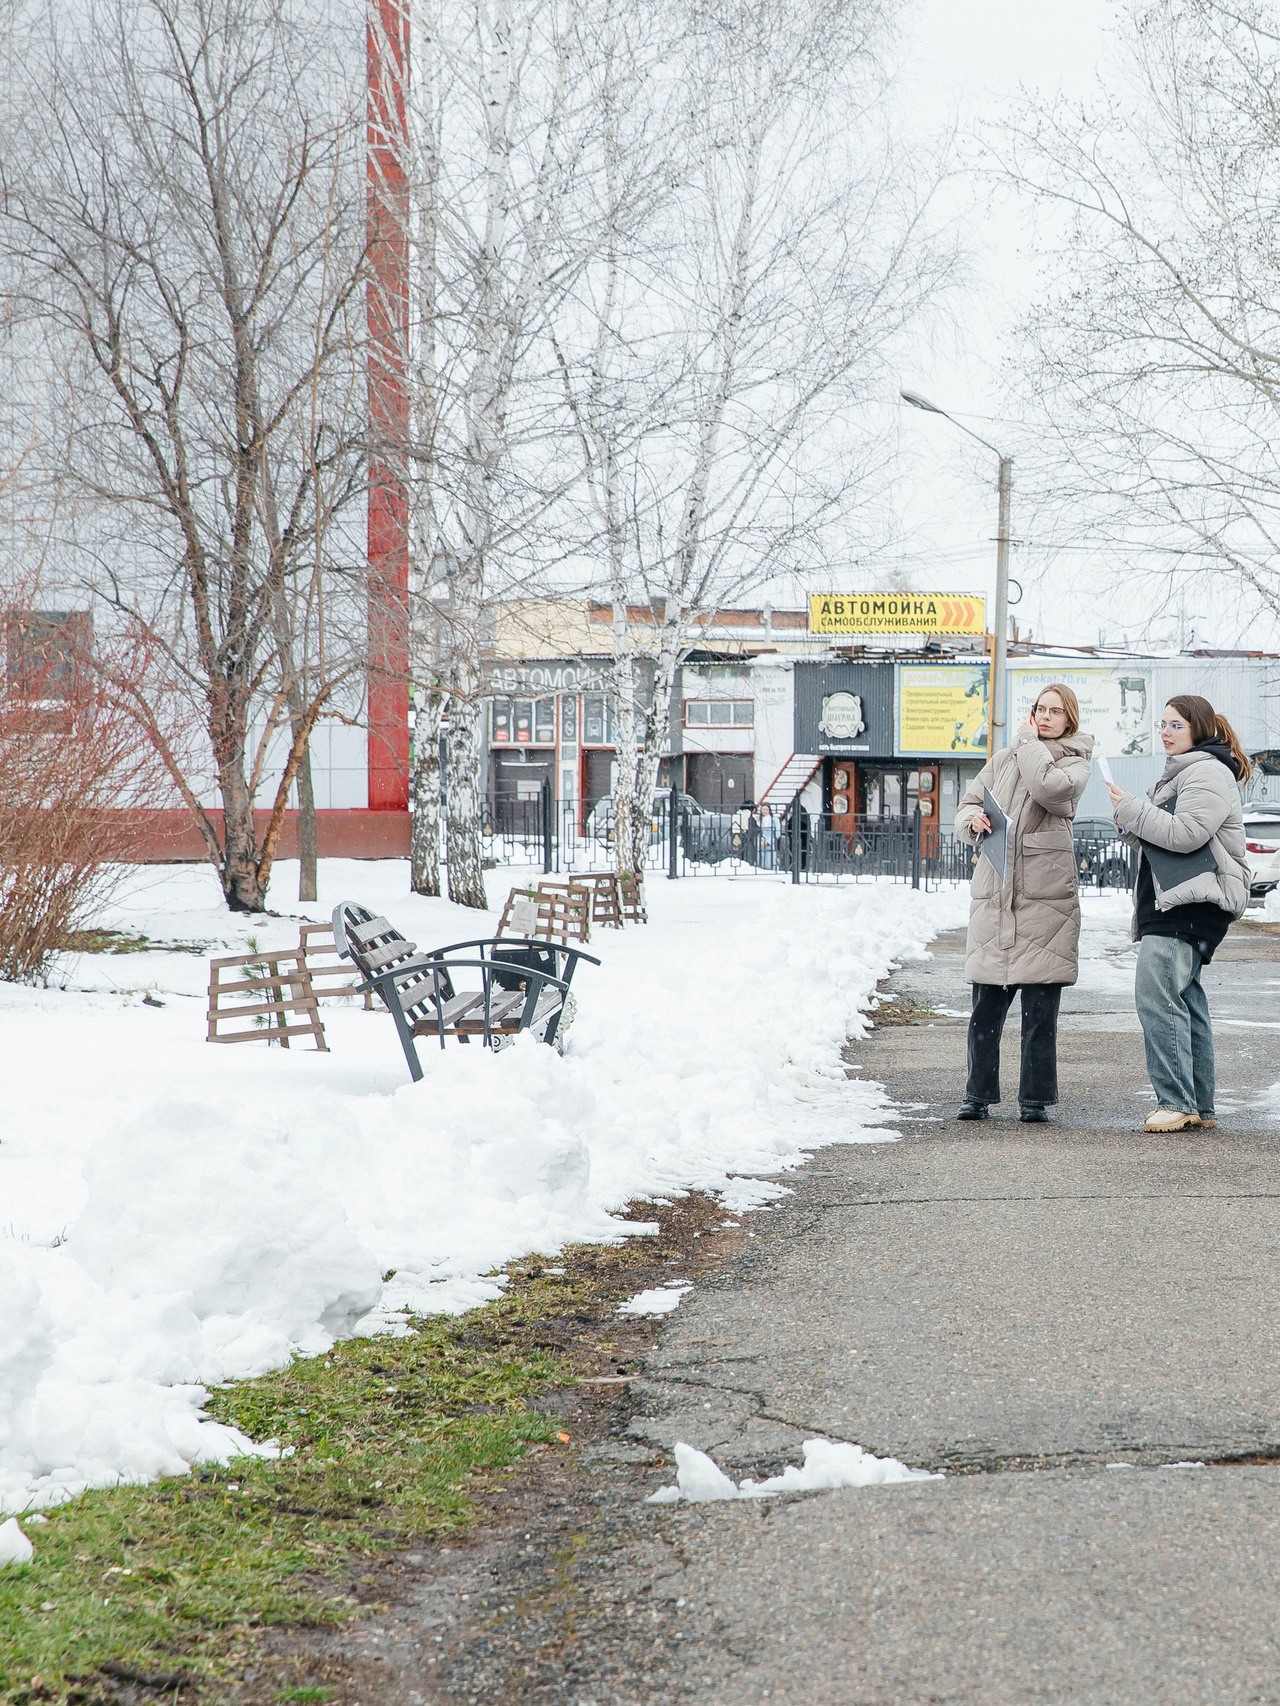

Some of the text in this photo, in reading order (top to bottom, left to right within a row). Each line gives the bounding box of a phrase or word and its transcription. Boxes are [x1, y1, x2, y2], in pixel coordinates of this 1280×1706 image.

[821, 598, 937, 615] АВТОМОЙКА
[821, 617, 937, 627] САМООБСЛУЖИВАНИЯ
[906, 672, 965, 684] prokat-70.ru
[1022, 674, 1087, 685] prokat-70.ru
